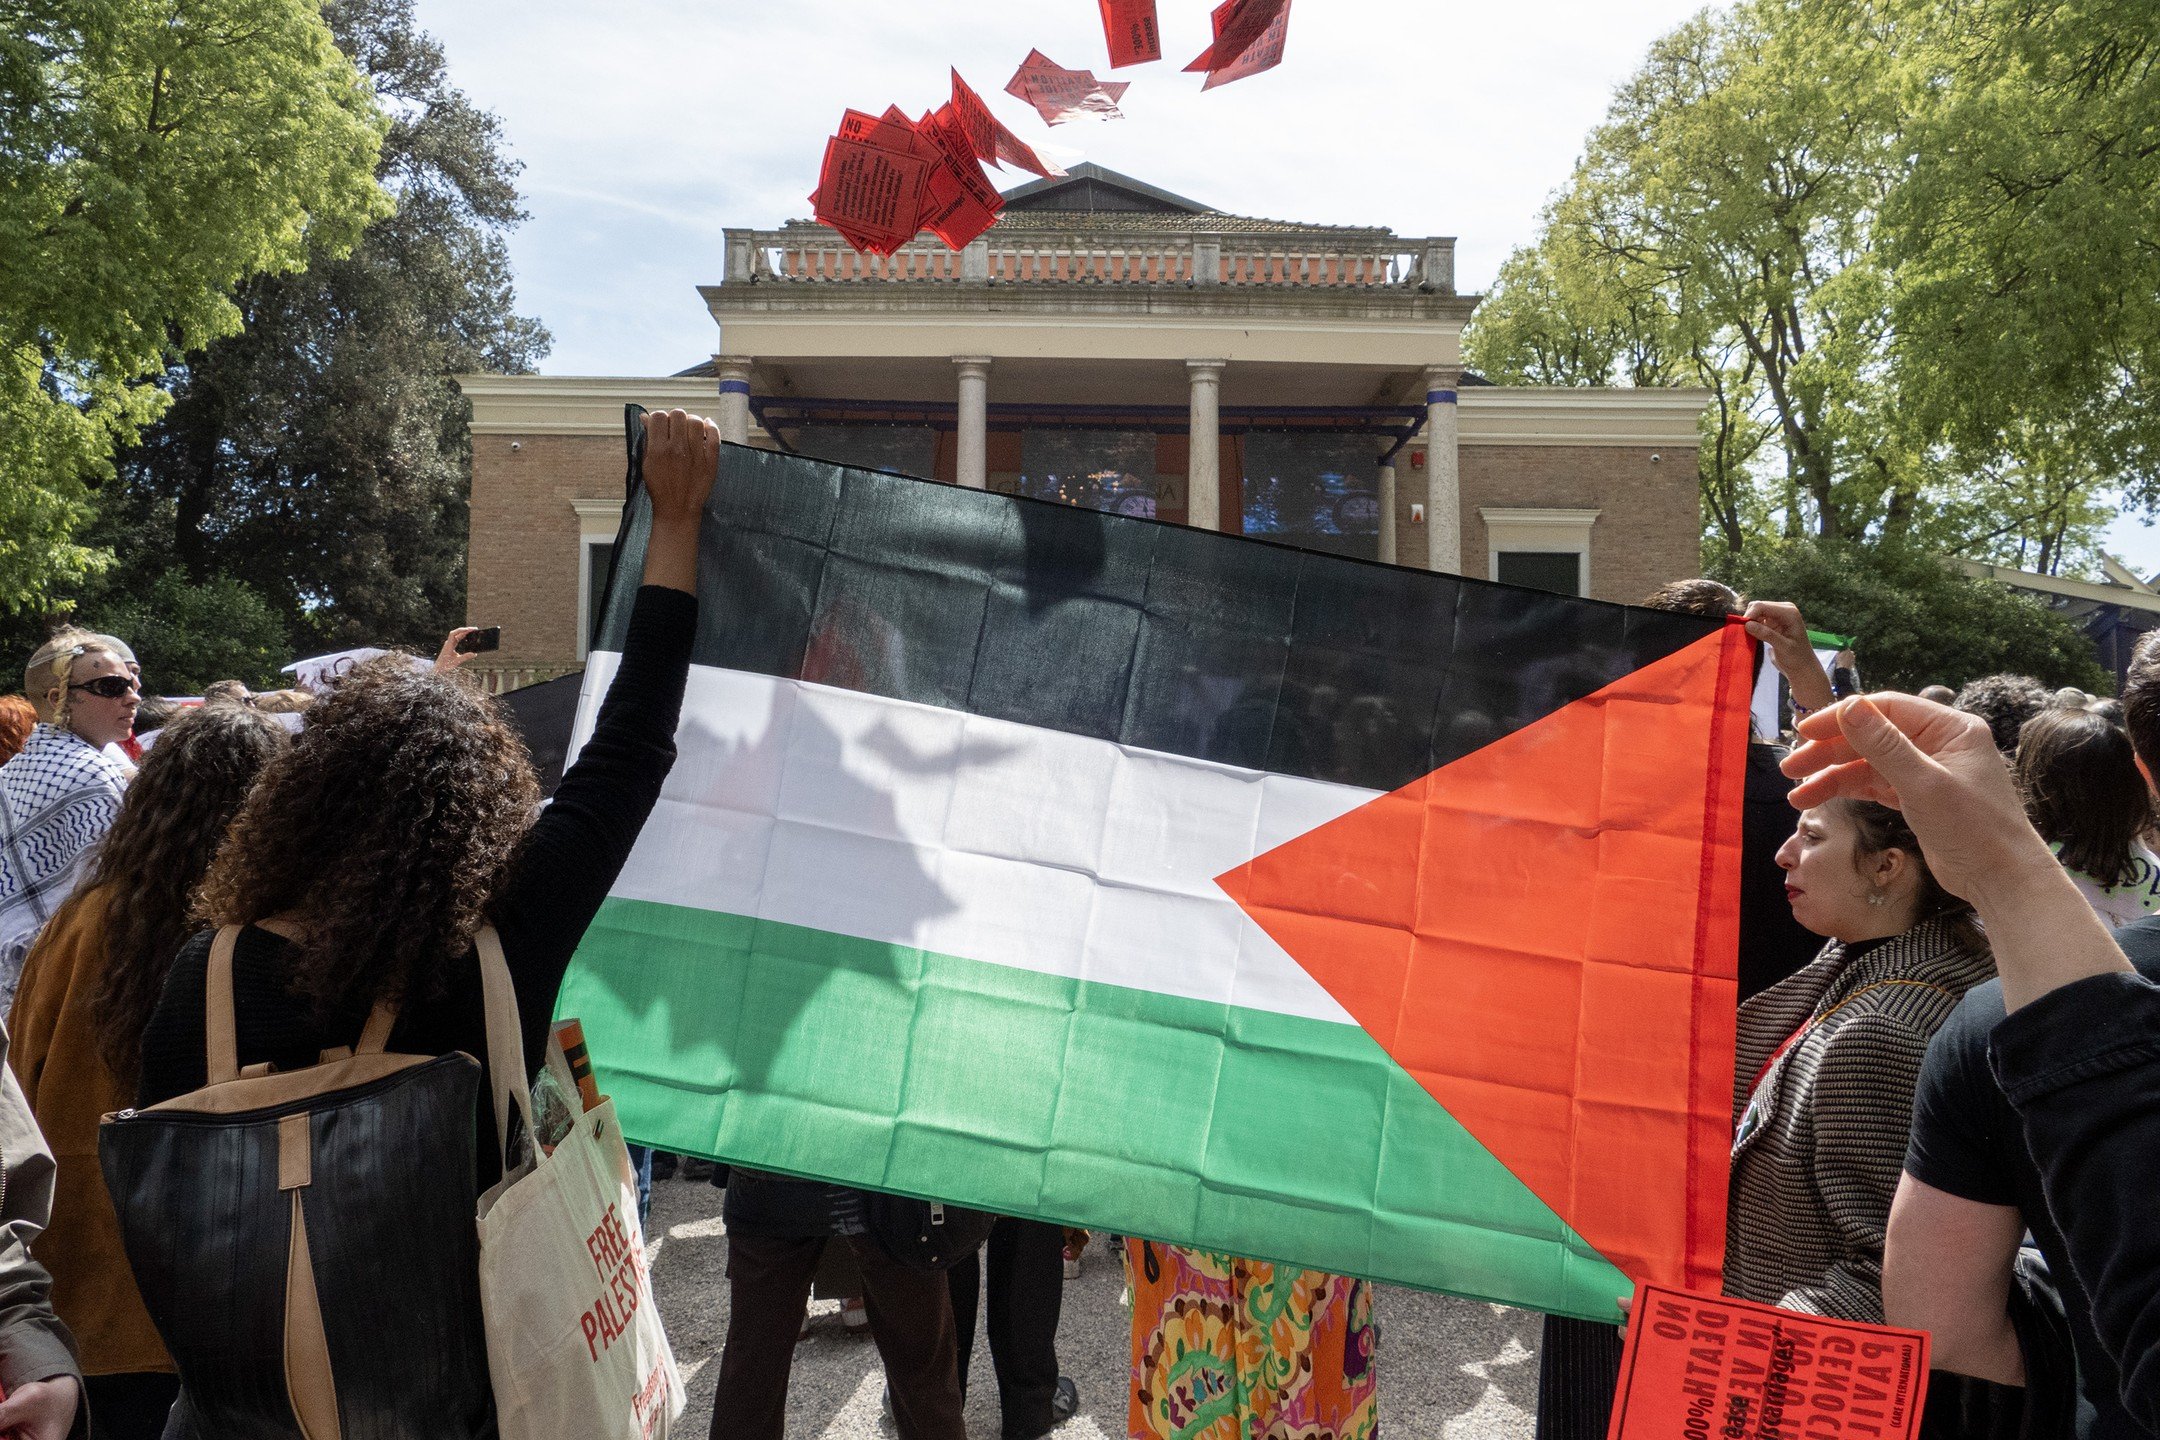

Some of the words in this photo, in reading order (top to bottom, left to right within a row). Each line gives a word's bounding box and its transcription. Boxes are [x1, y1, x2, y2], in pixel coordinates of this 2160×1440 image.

[1143, 17, 1156, 53] increase
[846, 118, 862, 134] NO
[586, 1202, 628, 1284] FREE
[580, 1231, 648, 1363] PALEST
[1754, 1323, 1796, 1440] iscarriages"
[1896, 1344, 1914, 1408] INTERNATIONAL)
[1683, 1397, 1715, 1440] 00%
[1890, 1408, 1904, 1429] (CARE
